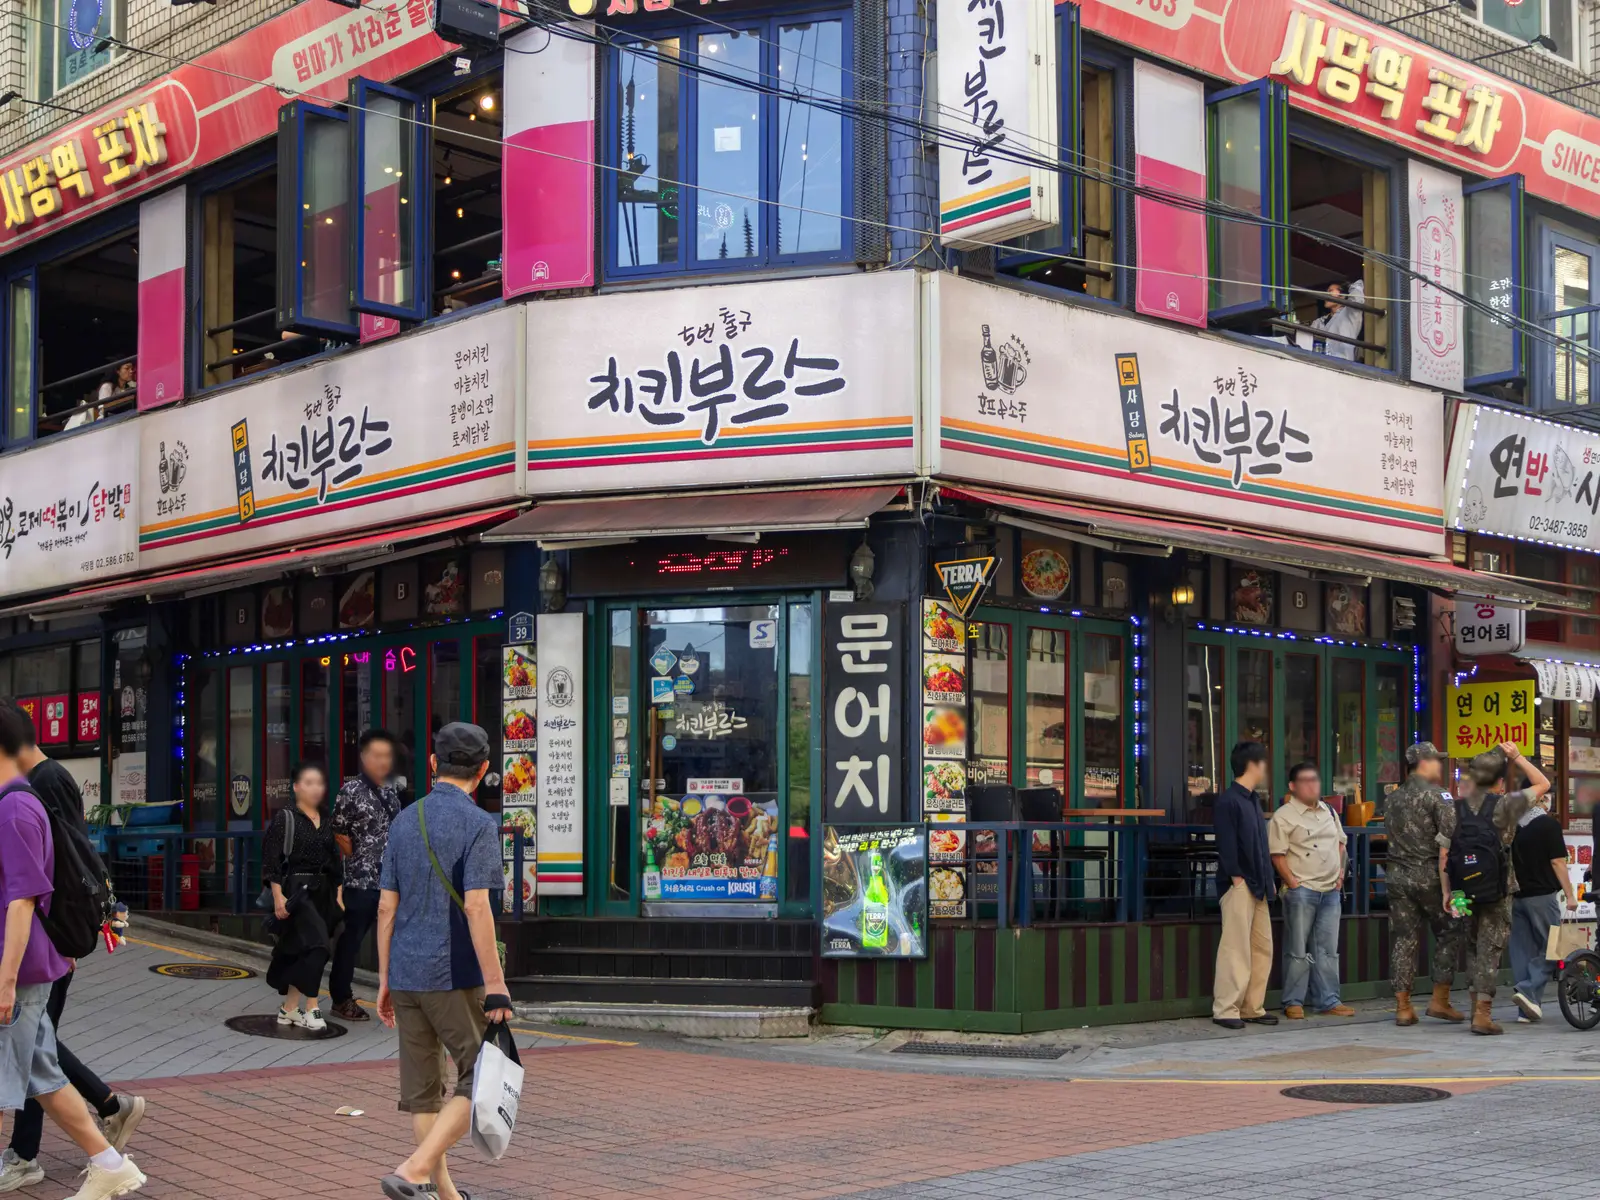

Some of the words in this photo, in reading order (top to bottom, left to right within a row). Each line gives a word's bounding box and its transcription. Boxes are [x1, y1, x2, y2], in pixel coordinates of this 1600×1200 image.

[293, 33, 344, 83] 엄마가
[347, 3, 403, 57] 차려준
[1271, 10, 1412, 120] 사당역
[1415, 67, 1503, 155] 포차
[0, 139, 94, 231] 사당역
[94, 102, 168, 186] 포차
[1551, 142, 1600, 184] SINCE
[678, 323, 715, 346] 5번
[719, 307, 752, 339] 출구
[455, 343, 489, 370] 문어치킨
[454, 369, 489, 396] 마늘치킨
[588, 338, 846, 442] 치킨부르스
[1238, 367, 1258, 397] 출구
[449, 394, 494, 424] 골뱅이소면
[1126, 389, 1142, 428] 사당
[1384, 409, 1412, 430] 문어치킨
[453, 420, 490, 448] 로제닭발
[1160, 388, 1313, 486] 치킨부르스
[1384, 432, 1413, 453] 마늘치킨
[261, 405, 393, 502] 치킨부르스
[1134, 444, 1145, 465] 5
[238, 450, 248, 485] 사당
[1384, 477, 1414, 497] 로제닭발
[18, 500, 80, 537] 로제떡볶이
[92, 484, 124, 522] 닭발
[243, 496, 251, 517] 5
[1529, 516, 1588, 538] 02-3487-3858
[941, 563, 985, 589] TERRA
[516, 626, 527, 639] 39
[931, 638, 959, 650] 문어치킨
[1461, 624, 1510, 643] 연어회
[834, 614, 893, 813] 문어치
[1456, 690, 1527, 718] 연어회
[81, 717, 98, 737] 닭발
[544, 719, 576, 731] 치킨부르스
[676, 711, 748, 740] 치킨부르스
[1456, 721, 1527, 749] 육사시미
[549, 739, 572, 748] 문어치킨
[549, 751, 572, 760] 마늘치킨
[232, 780, 251, 792] TERRA
[968, 767, 987, 785] 비어
[696, 884, 715, 892] Crush
[727, 881, 756, 896] KRUSH
[830, 941, 852, 949] TERRA
